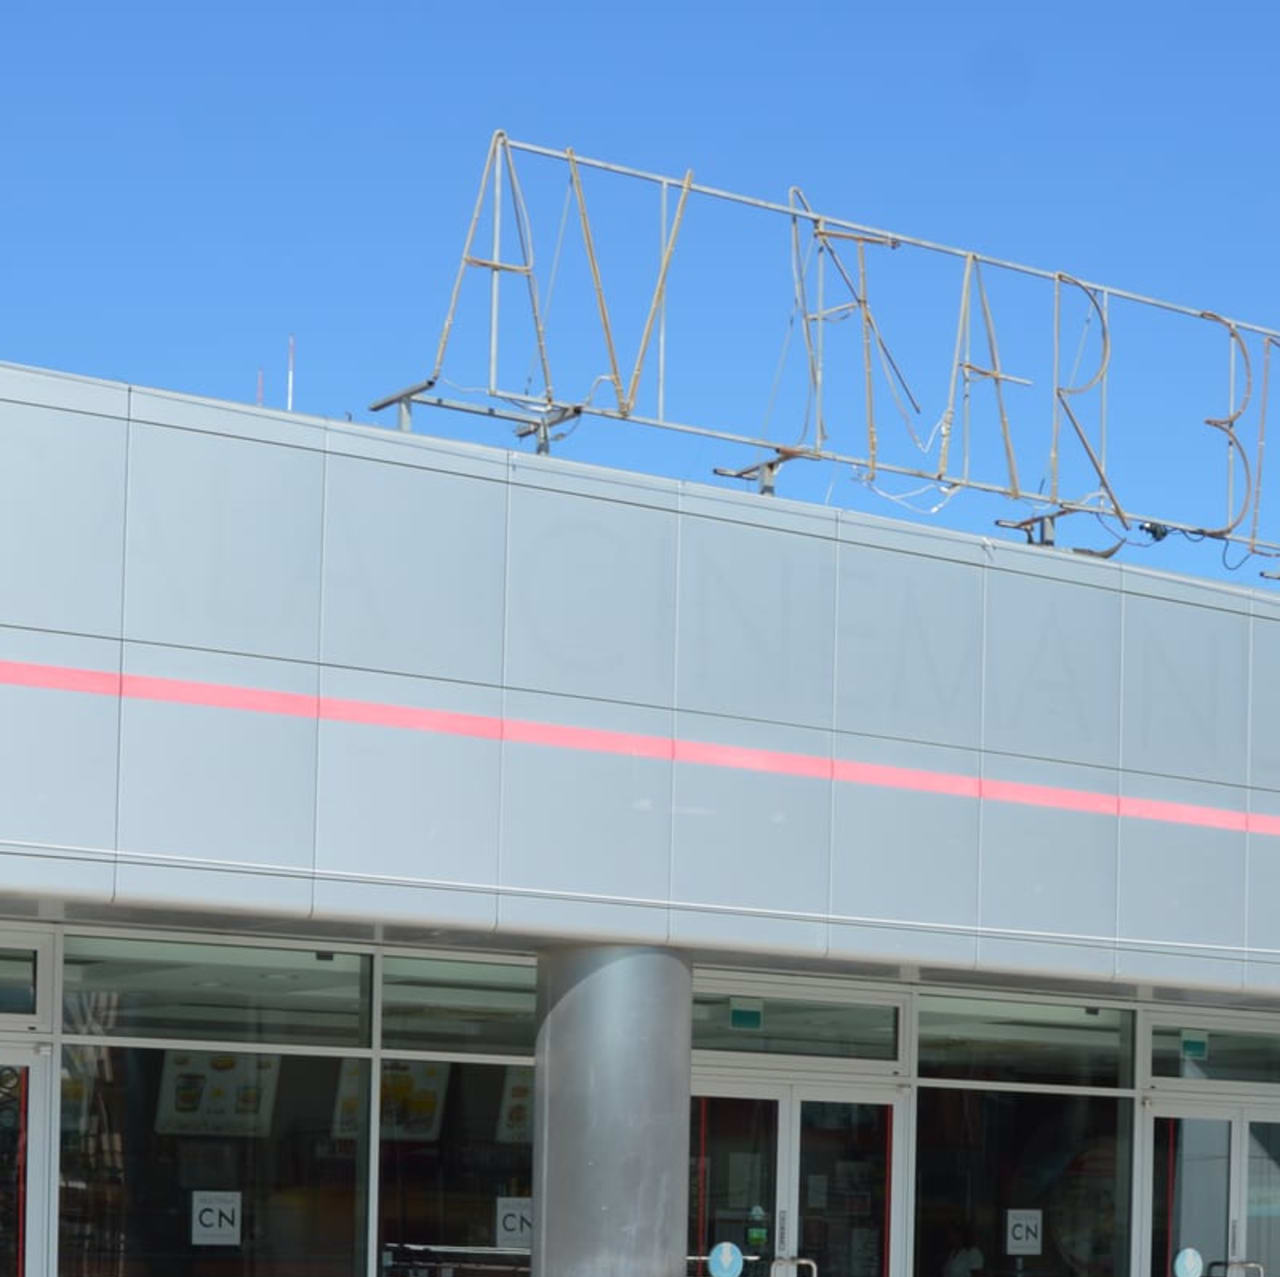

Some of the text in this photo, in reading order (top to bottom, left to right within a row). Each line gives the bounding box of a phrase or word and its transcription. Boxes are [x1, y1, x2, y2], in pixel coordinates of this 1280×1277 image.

[432, 128, 1131, 531] AVATAR
[198, 1206, 236, 1229] CN
[502, 1211, 533, 1233] CN
[1011, 1222, 1038, 1242] CN
